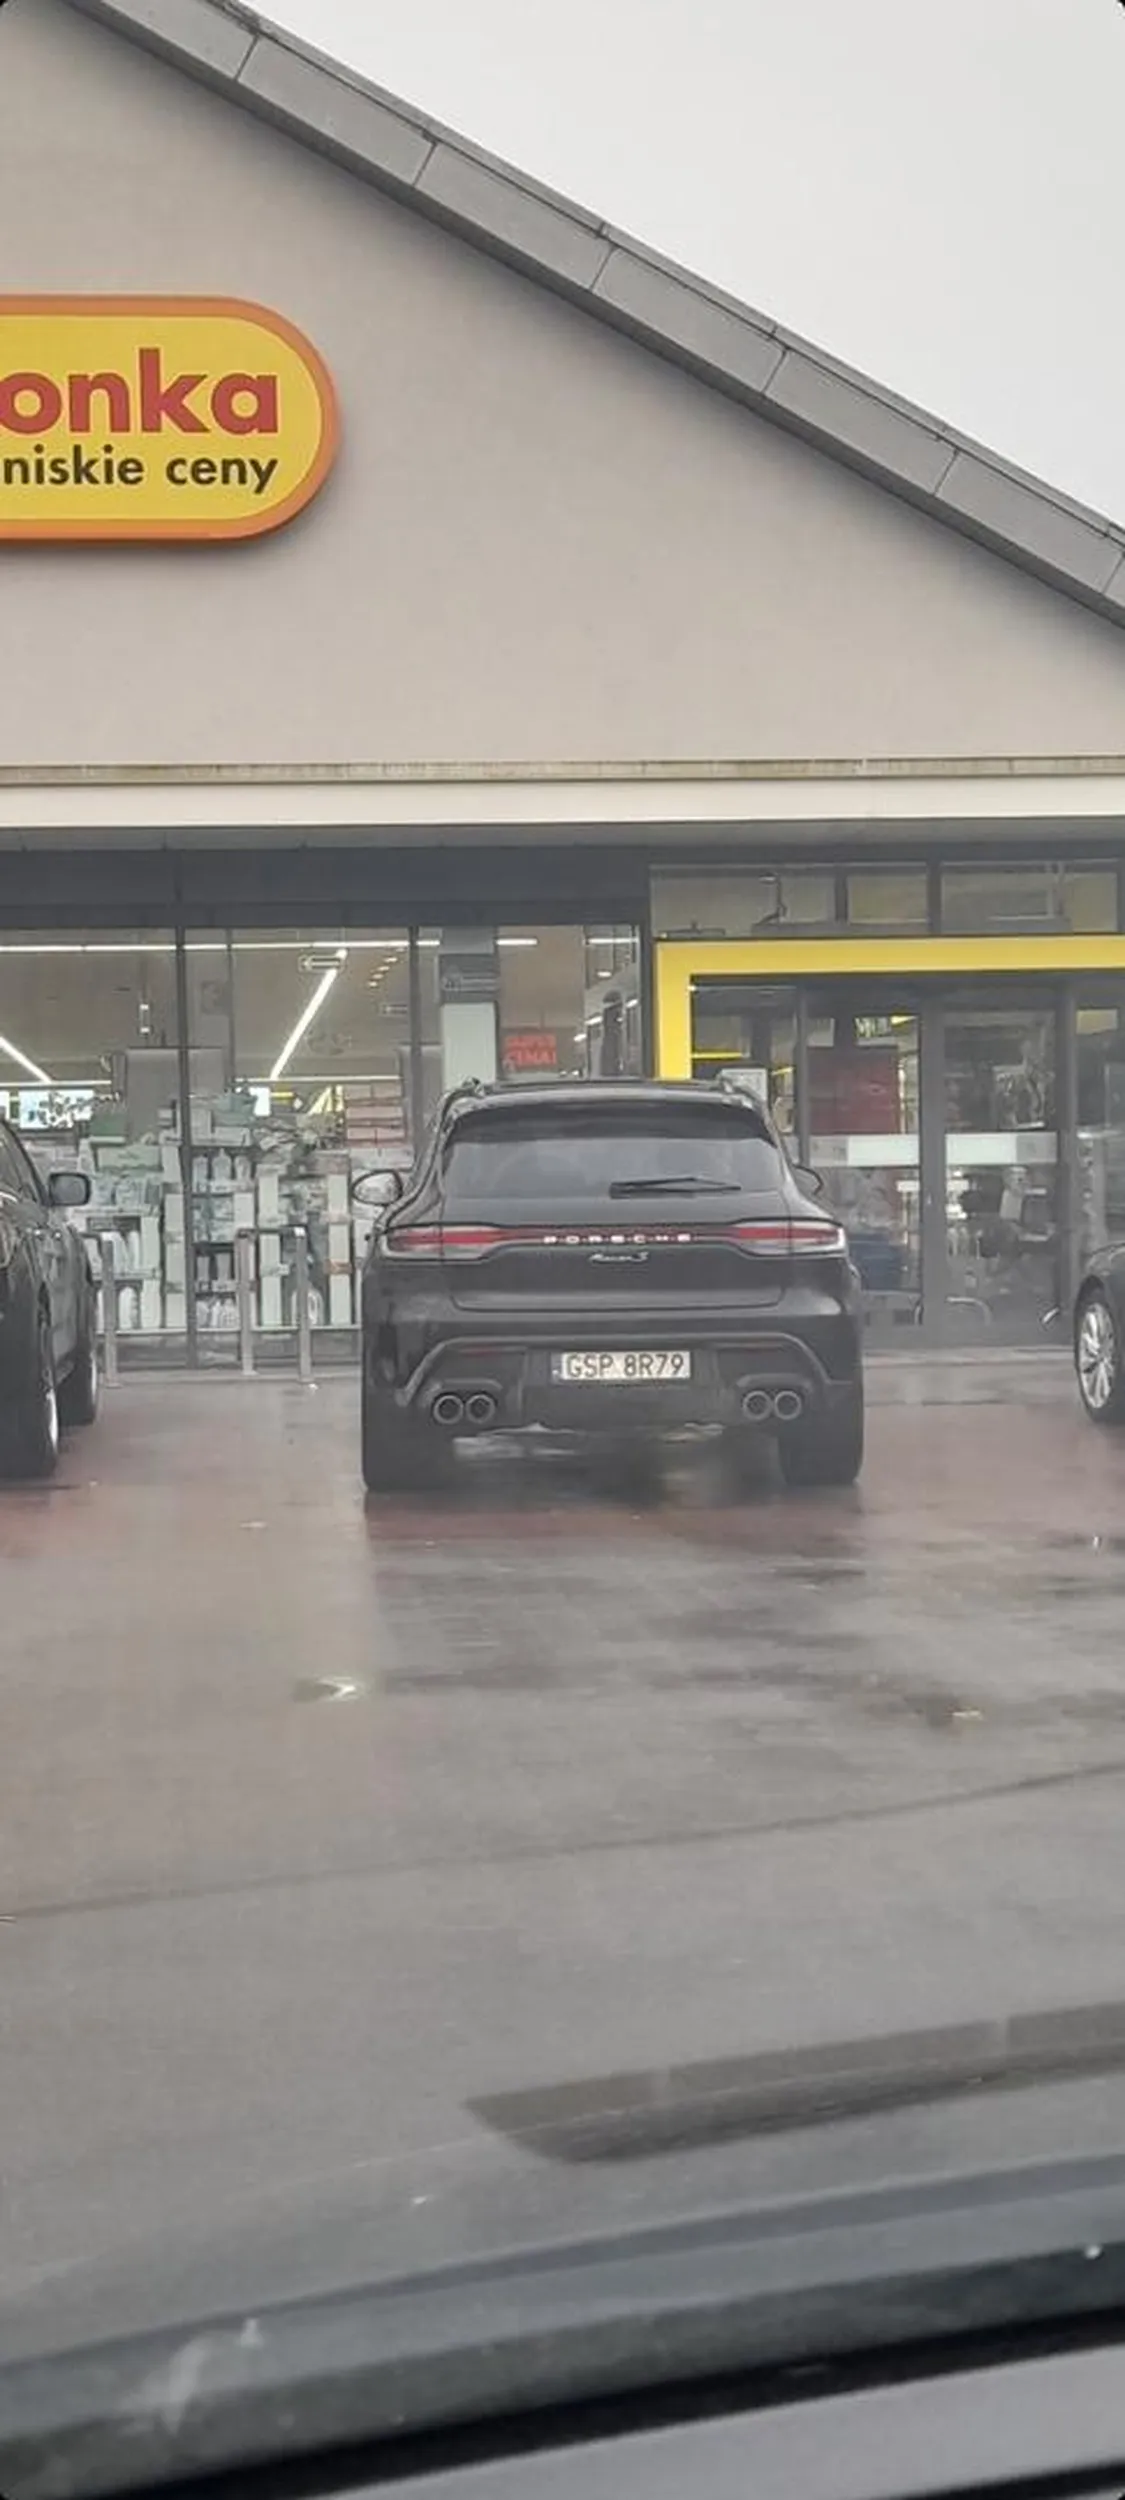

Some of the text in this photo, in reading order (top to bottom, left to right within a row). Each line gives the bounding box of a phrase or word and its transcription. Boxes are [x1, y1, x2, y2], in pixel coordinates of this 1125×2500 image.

[0, 347, 279, 434] onka
[3, 444, 279, 495] niskie ceny
[543, 1233, 691, 1244] PORSCHE
[566, 1353, 684, 1378] GSP 8R79
